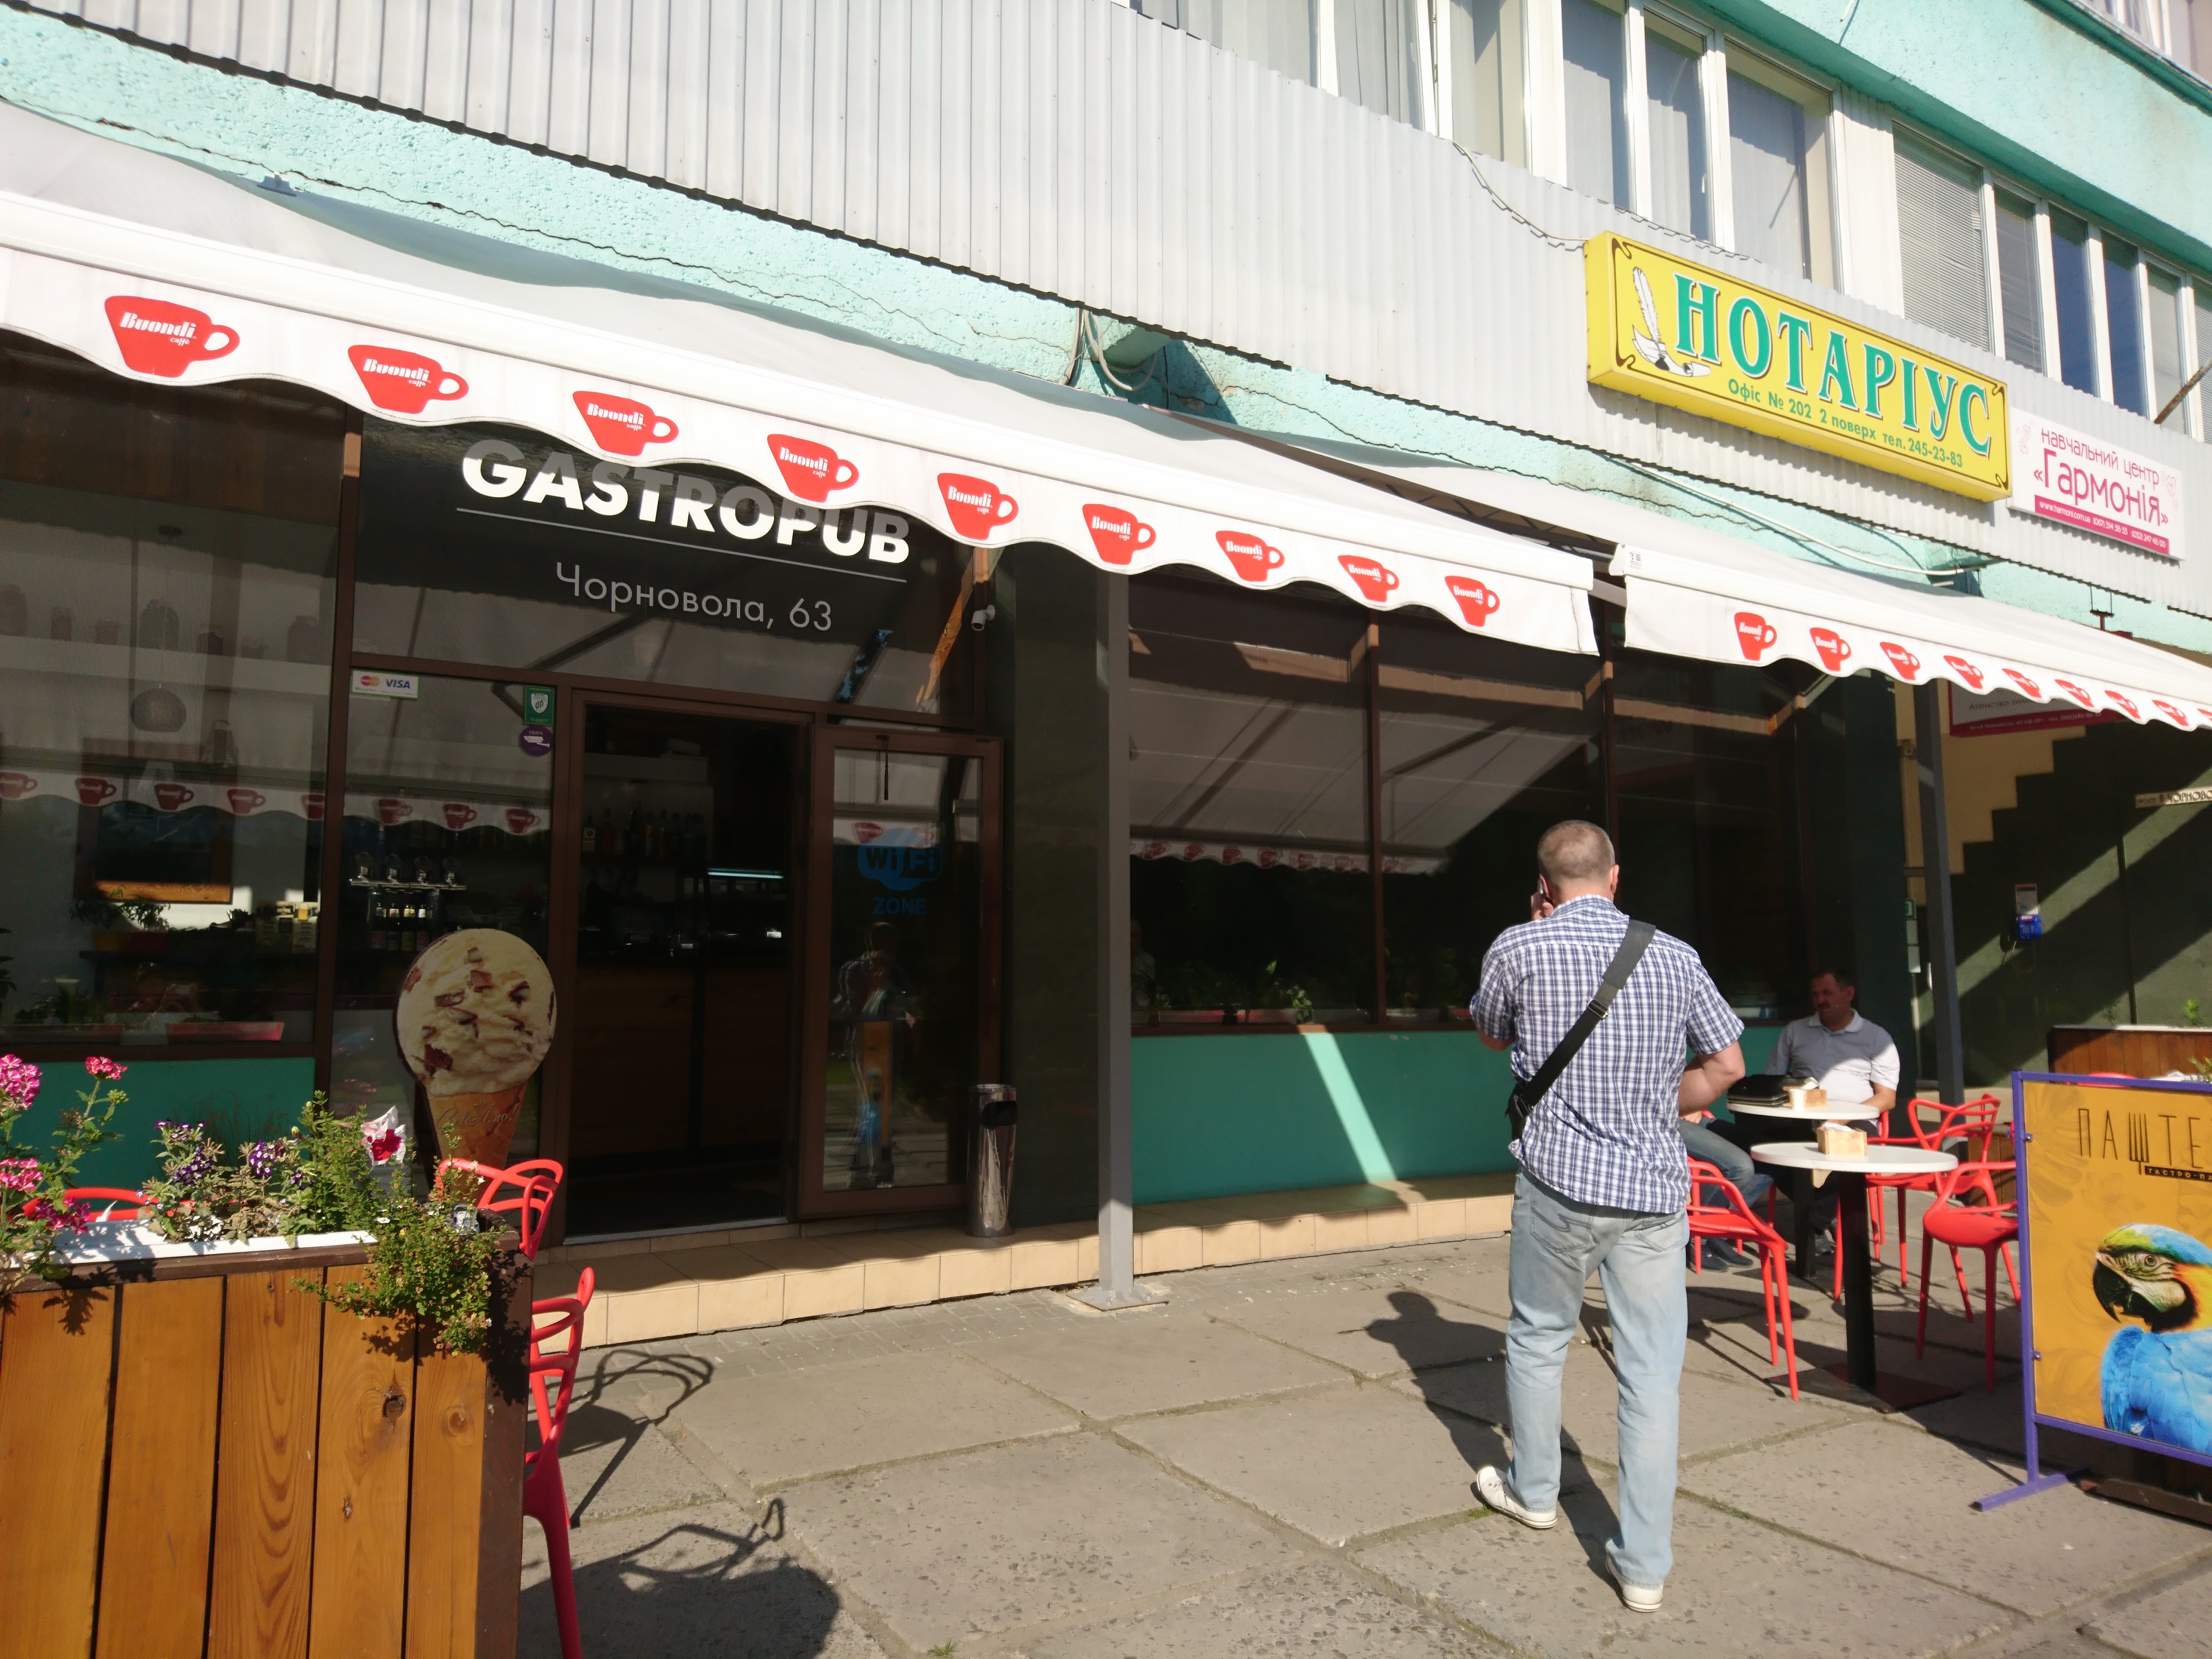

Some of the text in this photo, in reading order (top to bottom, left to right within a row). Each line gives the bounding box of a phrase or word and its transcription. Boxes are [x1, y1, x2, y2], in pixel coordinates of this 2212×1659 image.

[120, 312, 196, 338] Buondi
[170, 337, 190, 346] caffè
[363, 358, 429, 382] Buondi
[1674, 273, 1992, 458] НОТАРІУС
[587, 403, 644, 425] Buondi
[1729, 379, 1963, 468] Офіс № 202 2 поверх тел. 245-23-83
[780, 447, 828, 472] Buondi
[2041, 428, 2159, 491] навчальний центр
[948, 486, 992, 508] Buondi
[2034, 448, 2169, 526] «Гармонія»
[462, 440, 909, 564] GASTROPUB
[1092, 516, 1131, 535] Buondi
[556, 562, 832, 631] Чорновола, 63
[386, 679, 410, 689] VISA
[873, 896, 928, 915] ZONE
